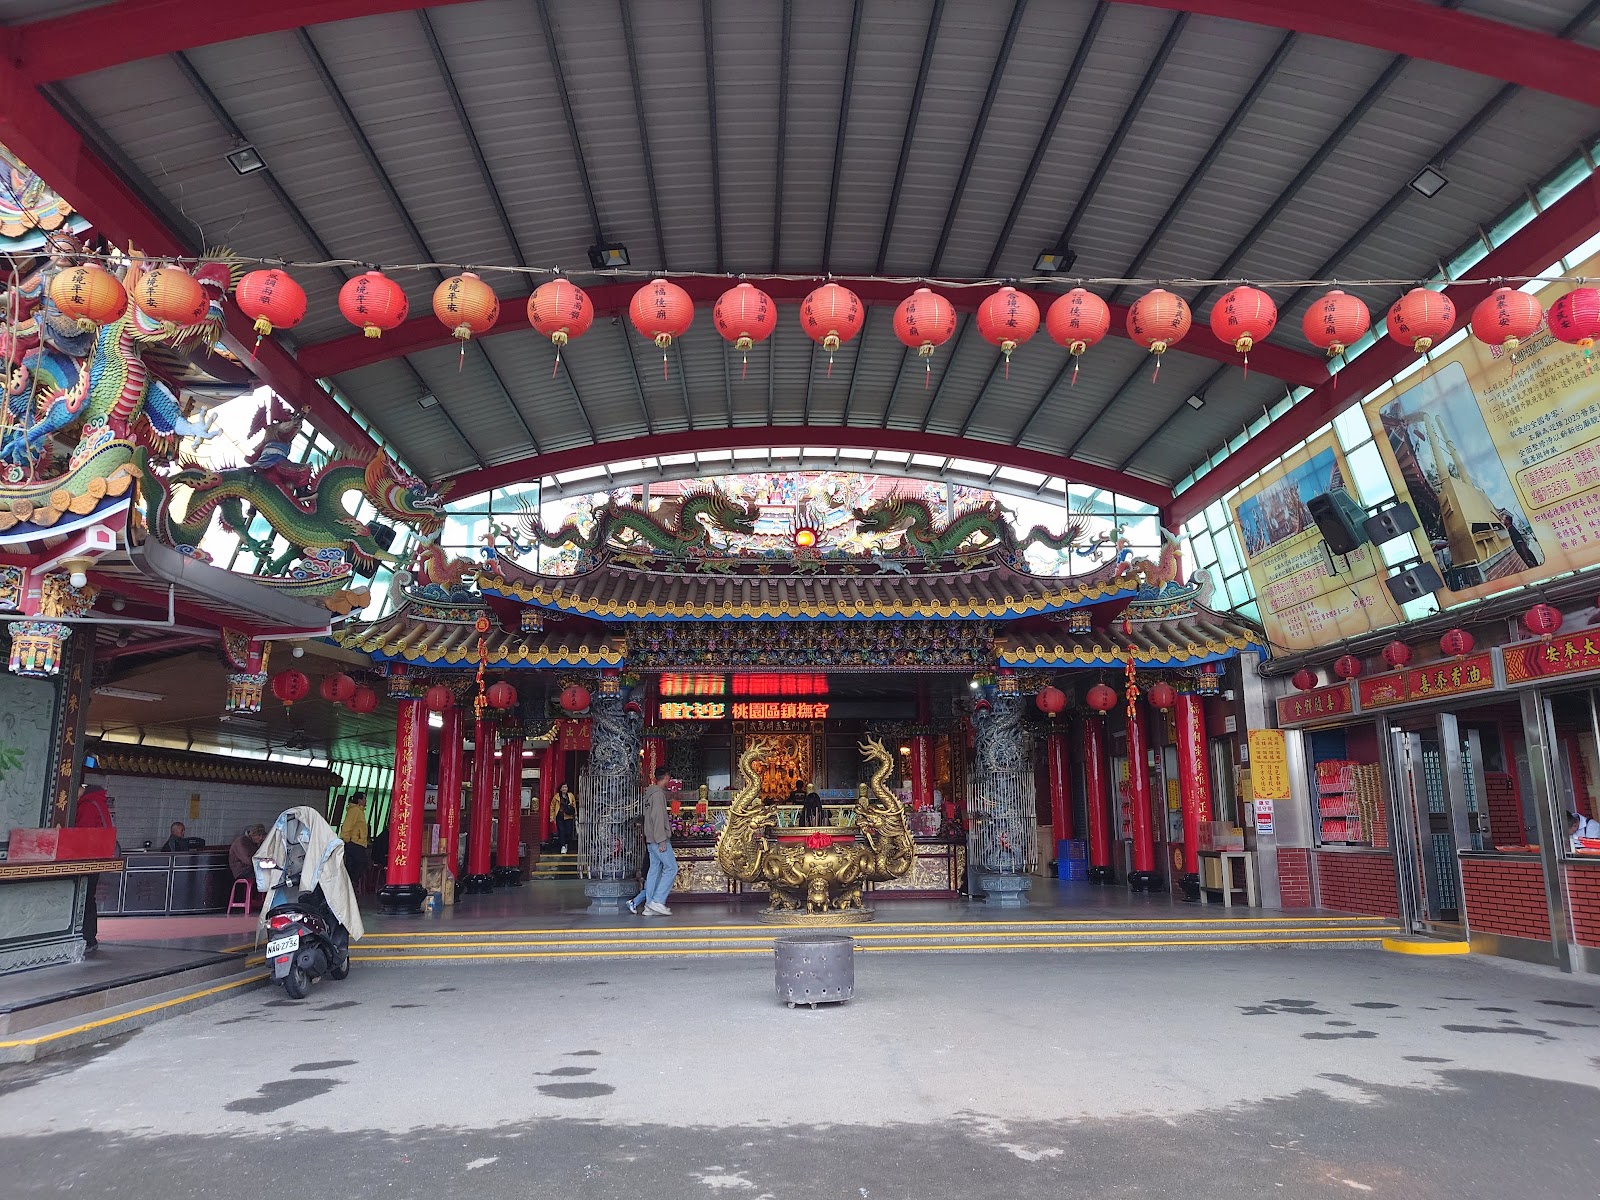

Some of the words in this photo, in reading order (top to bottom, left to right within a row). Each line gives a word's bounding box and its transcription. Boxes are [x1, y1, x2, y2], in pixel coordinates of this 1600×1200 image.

[70, 268, 90, 305] 合境平安
[145, 271, 162, 308] 合境平安
[258, 273, 279, 305] 風調雨順
[355, 277, 371, 315] 合境平安
[447, 277, 464, 313] 合境平安
[654, 287, 667, 320] 福德廟
[1005, 292, 1020, 328] 合境平安
[1069, 295, 1083, 328] 福德廟
[1323, 303, 1336, 335] 福德廟
[1419, 665, 1481, 694] 喜添香油
[659, 702, 726, 720] 歡迎
[732, 702, 830, 719] 桃園區鎮撫宮
